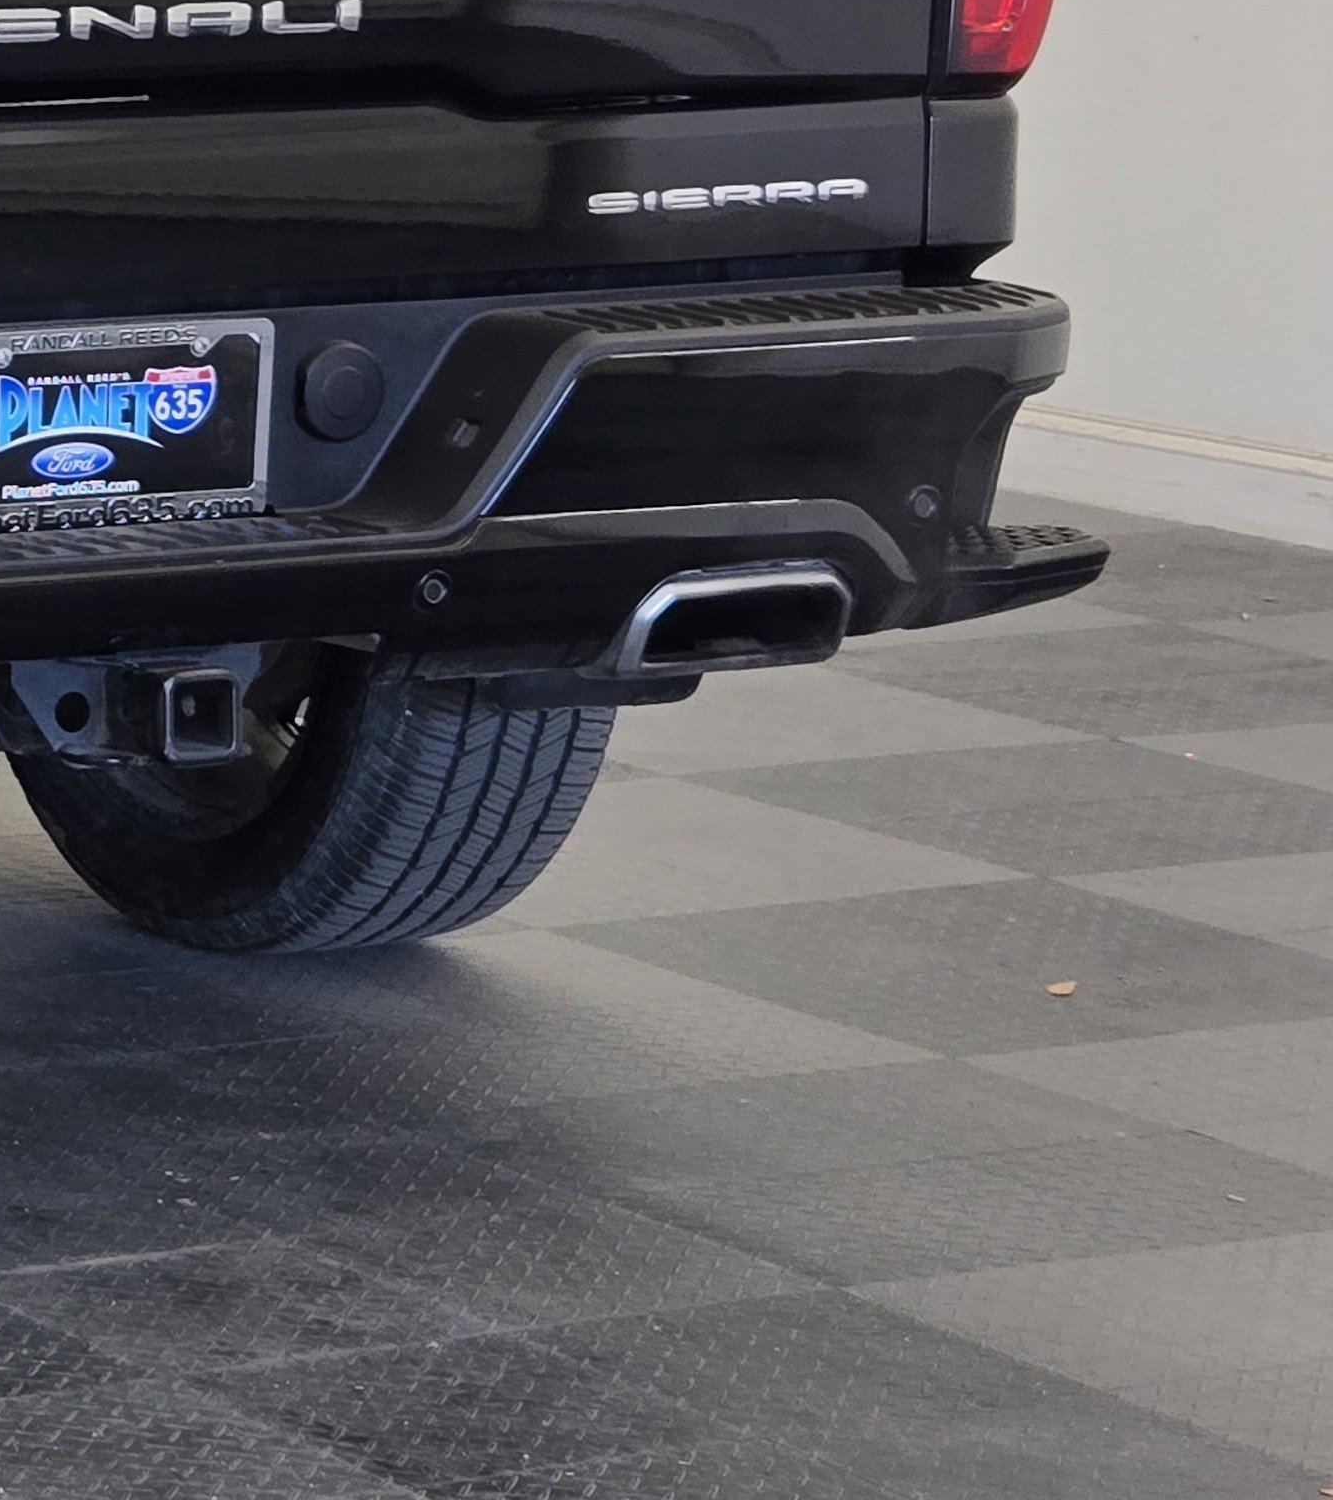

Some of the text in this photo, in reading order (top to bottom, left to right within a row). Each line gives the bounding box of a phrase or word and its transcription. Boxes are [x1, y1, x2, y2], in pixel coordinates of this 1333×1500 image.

[587, 178, 870, 215] SIERRA
[10, 329, 113, 352] RANDALL
[155, 389, 204, 420] 635
[47, 450, 98, 473] Ford
